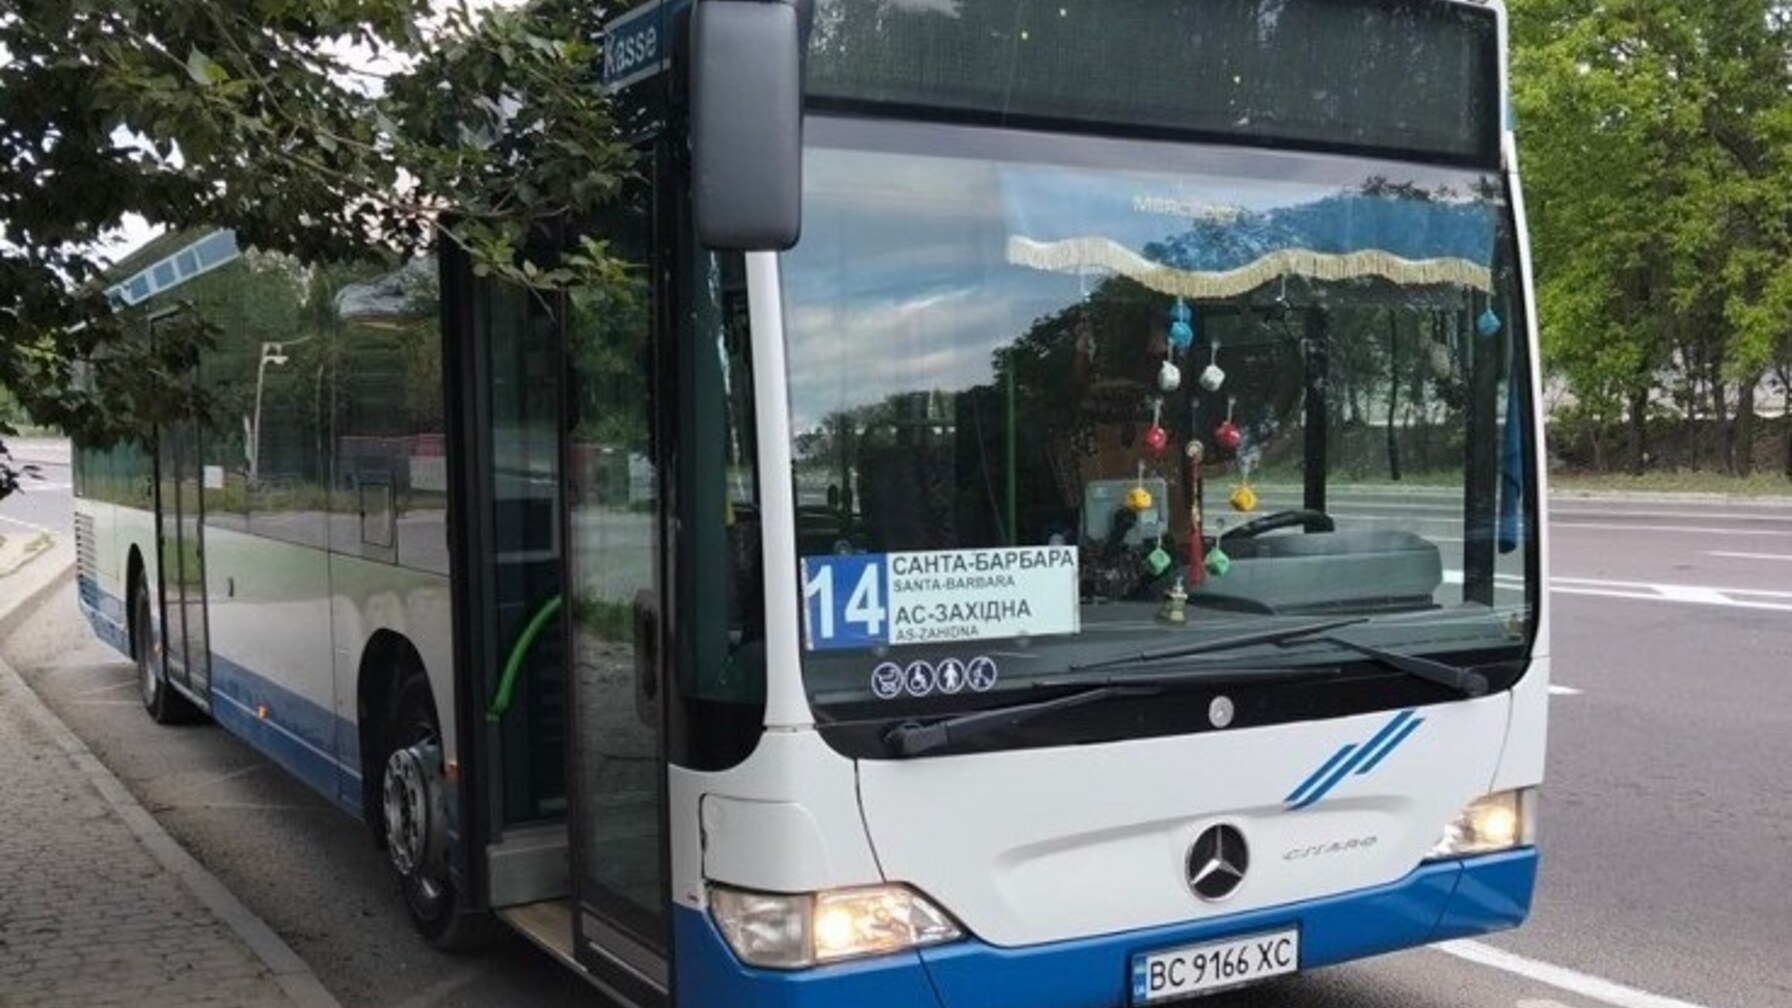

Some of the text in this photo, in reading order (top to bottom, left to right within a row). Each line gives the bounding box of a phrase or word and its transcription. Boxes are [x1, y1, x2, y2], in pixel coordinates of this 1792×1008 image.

[603, 25, 657, 78] Kasse
[893, 549, 1074, 576] САНТА-БАРБАРА
[893, 575, 1015, 593] SANTA-BARBARA
[805, 563, 886, 639] 14
[895, 599, 1032, 626] АС-ЗАХІДНА
[895, 625, 979, 641] AS-ZAHIDNA
[1150, 938, 1292, 991] BC 9166 XC
